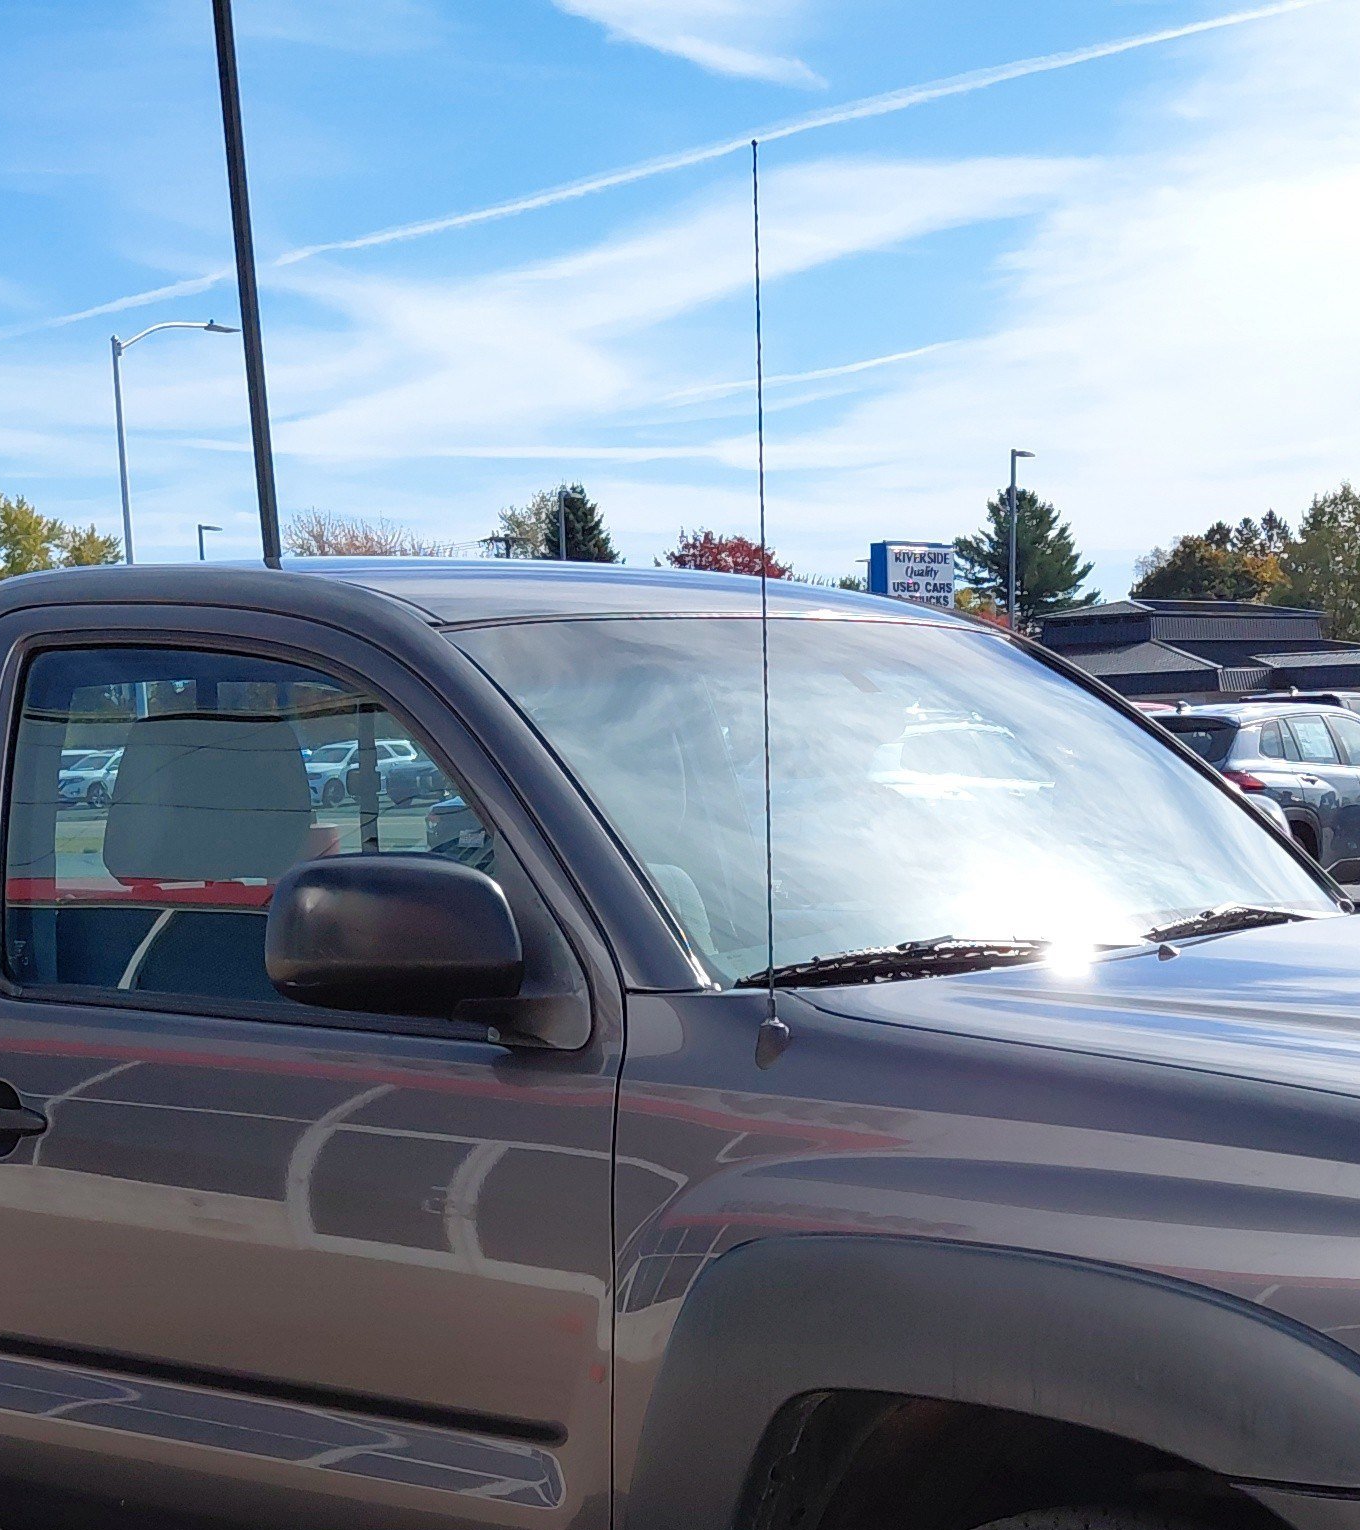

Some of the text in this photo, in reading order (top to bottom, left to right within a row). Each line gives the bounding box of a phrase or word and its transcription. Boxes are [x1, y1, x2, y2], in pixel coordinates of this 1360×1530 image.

[894, 551, 950, 564] RIVERSIDE
[905, 565, 939, 580] Quality
[892, 581, 952, 593] USED CARS
